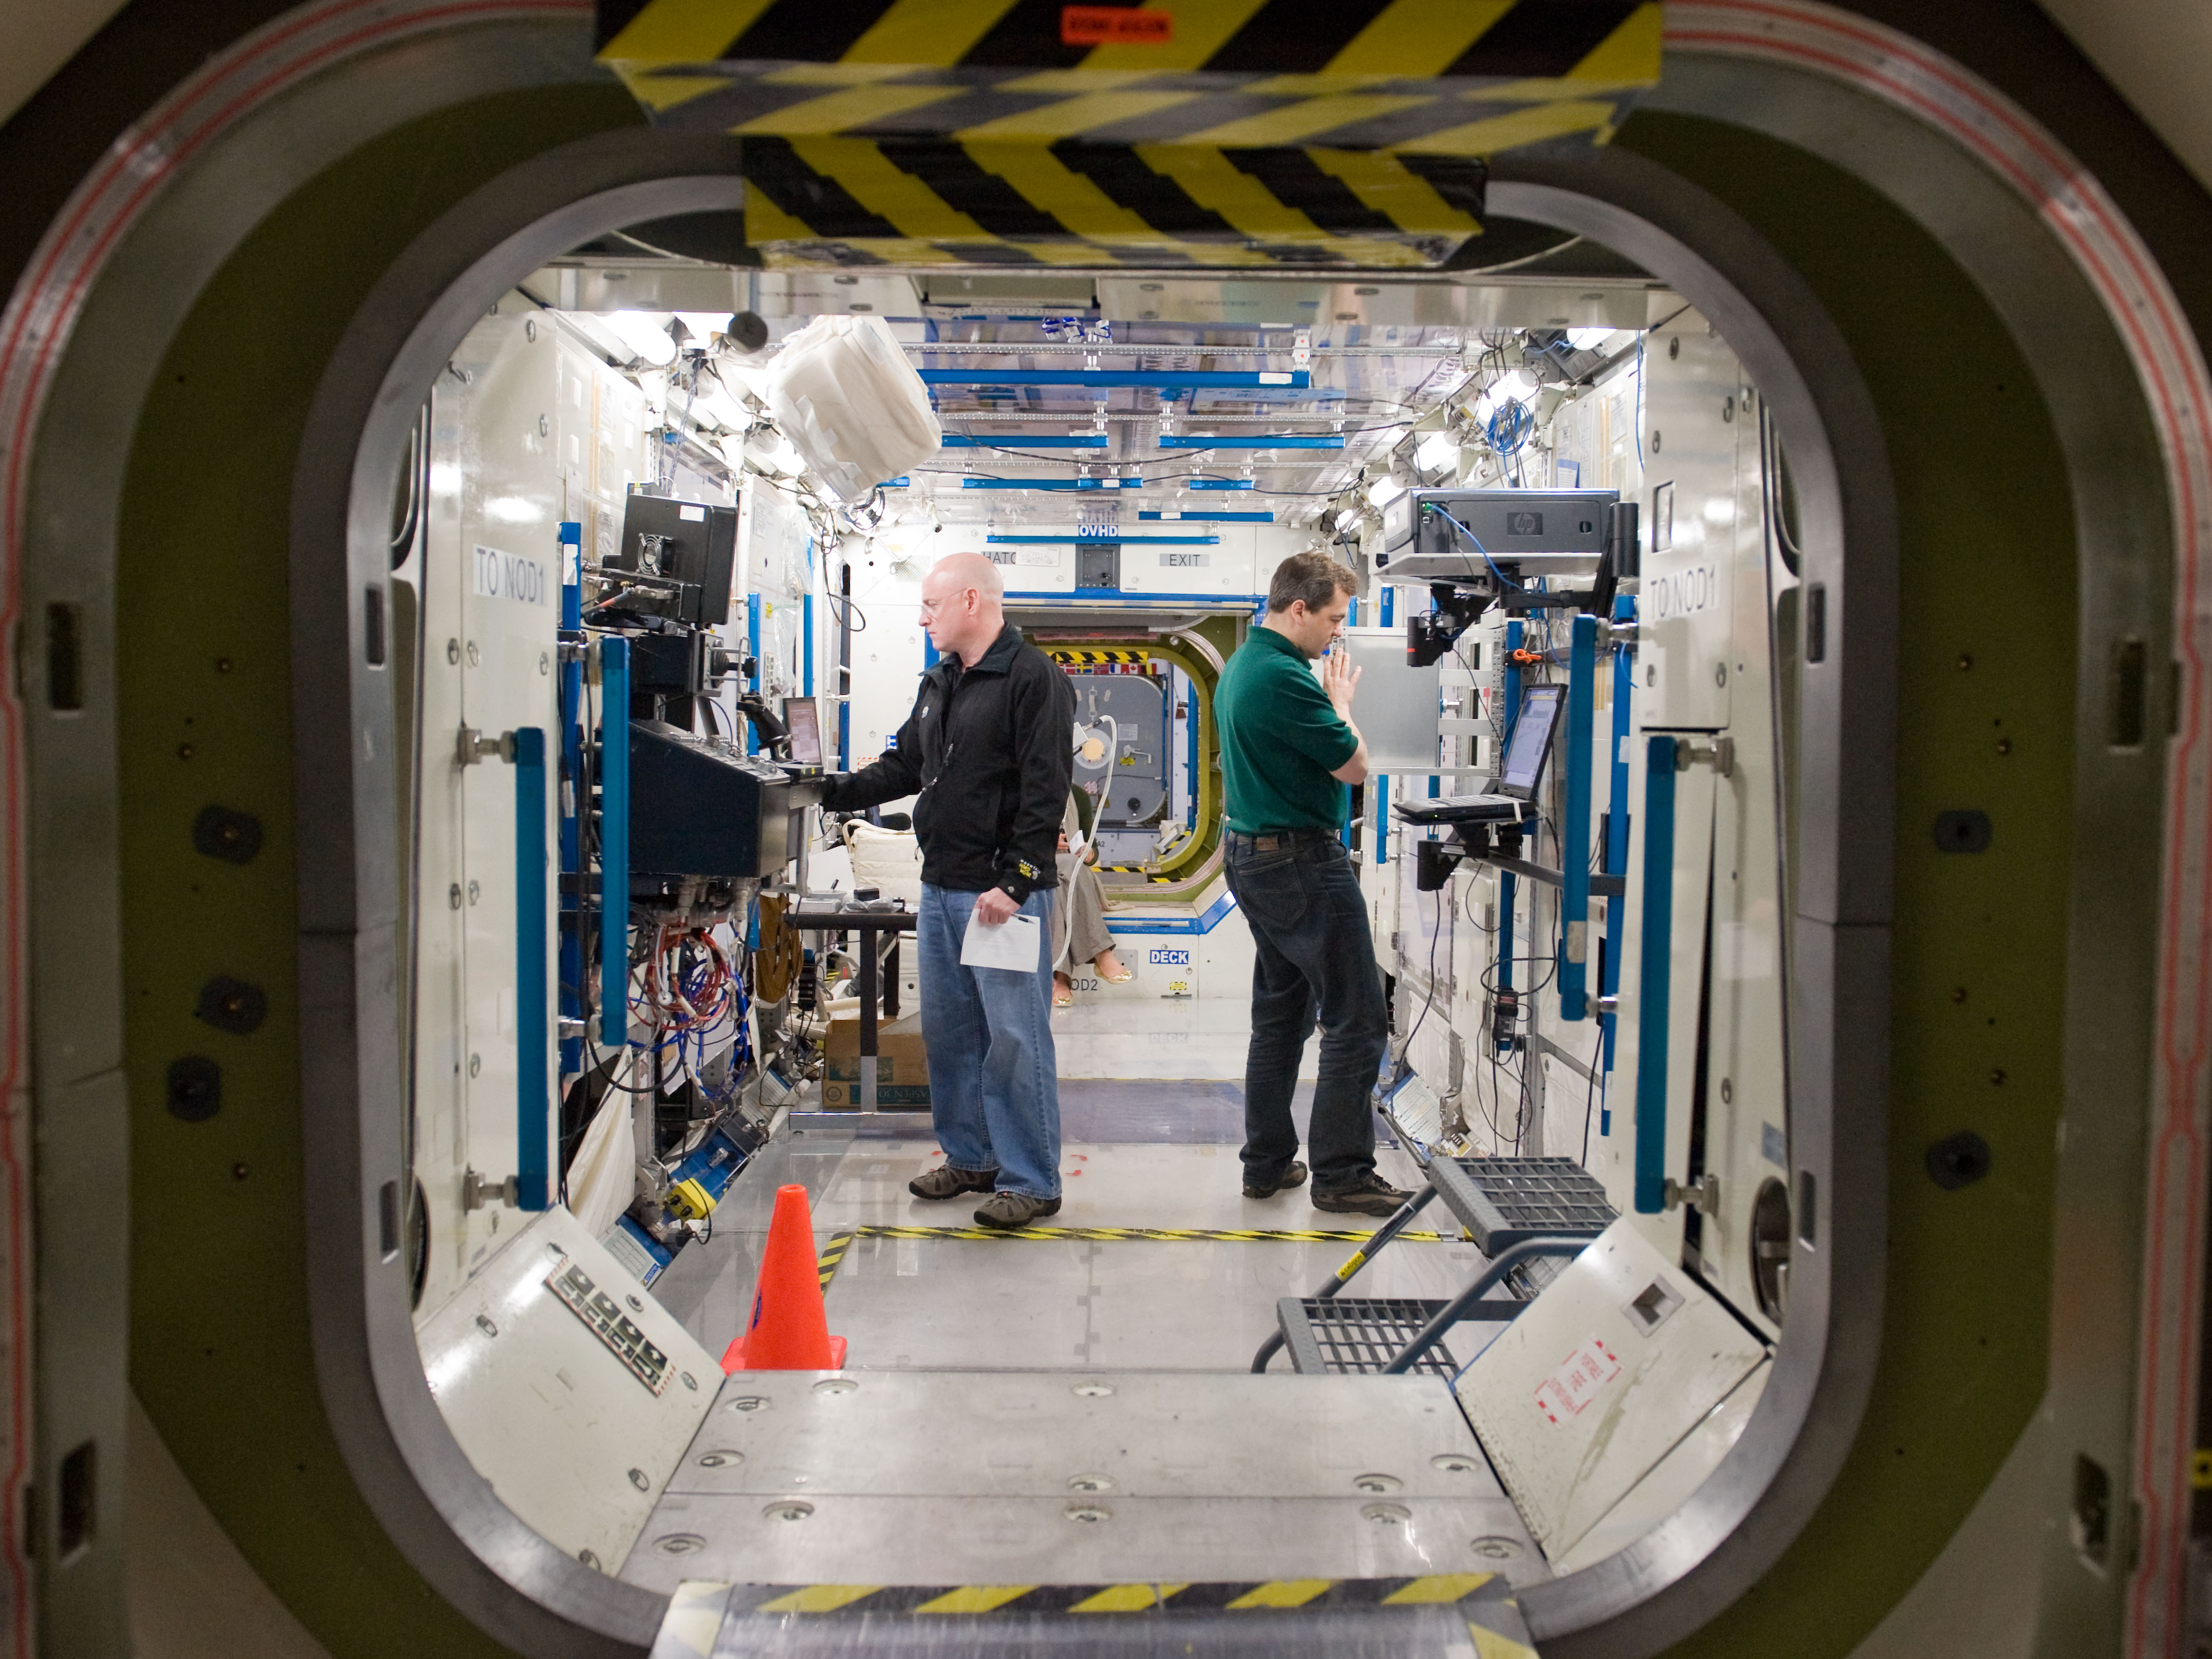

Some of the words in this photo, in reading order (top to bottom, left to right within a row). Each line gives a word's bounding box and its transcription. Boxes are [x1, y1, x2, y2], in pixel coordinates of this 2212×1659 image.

[1080, 525, 1118, 537] OVHD
[1169, 554, 1201, 566] EXIT
[476, 547, 497, 596] TO
[505, 555, 543, 605] NOD1
[1650, 577, 1669, 619] TO
[1673, 564, 1715, 615] NOD1
[1151, 950, 1188, 963] DECK
